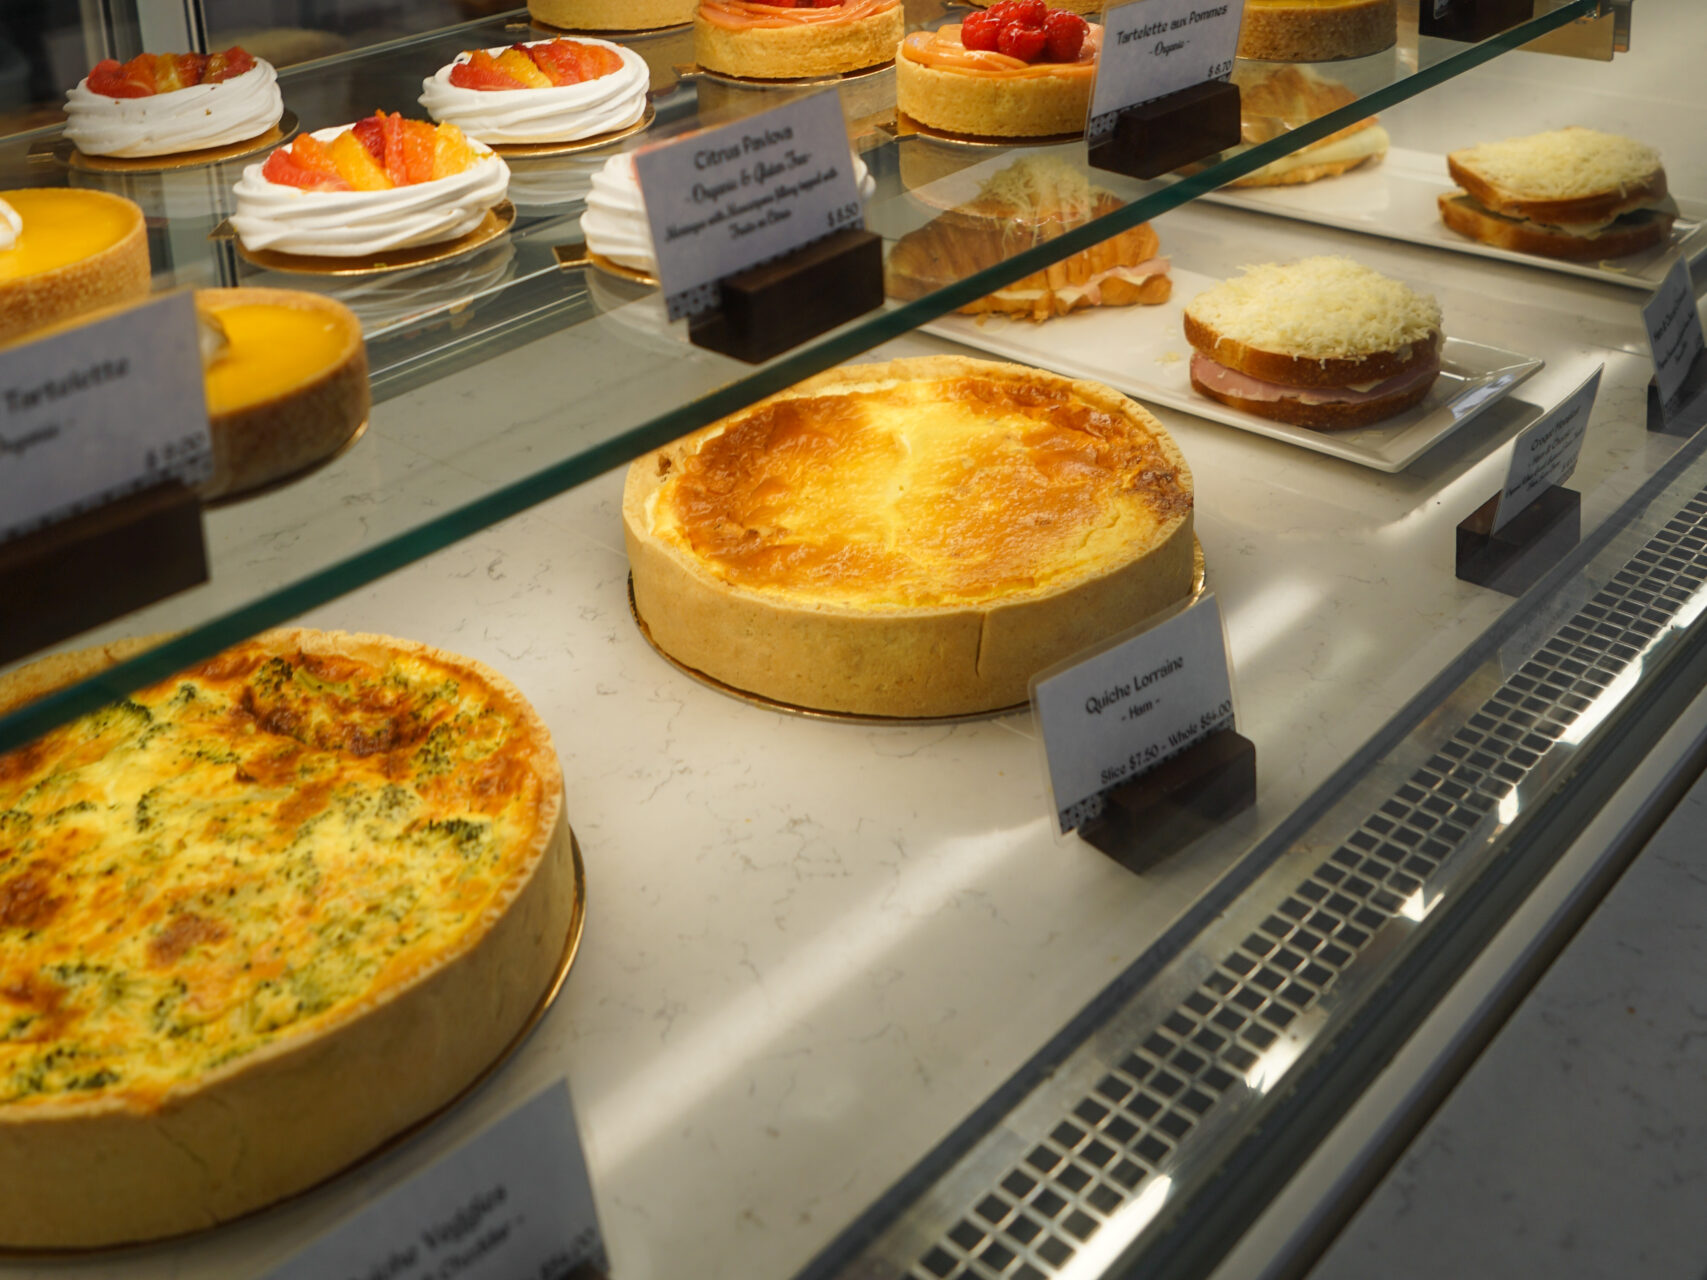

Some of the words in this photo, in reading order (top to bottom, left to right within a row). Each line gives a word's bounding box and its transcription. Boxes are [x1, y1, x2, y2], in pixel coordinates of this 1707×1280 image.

[1116, 22, 1168, 46] Tartelette
[1170, 16, 1187, 31] aux
[1189, 4, 1228, 25] Pommes
[1154, 39, 1185, 57] Organic
[694, 142, 741, 171] Citrus
[741, 126, 793, 152] Pavlova
[1085, 684, 1131, 715] Quiche
[1133, 656, 1184, 692] Lorraine
[1128, 701, 1154, 721] Ham
[1101, 765, 1127, 785] Slice
[1168, 723, 1198, 748] Whole
